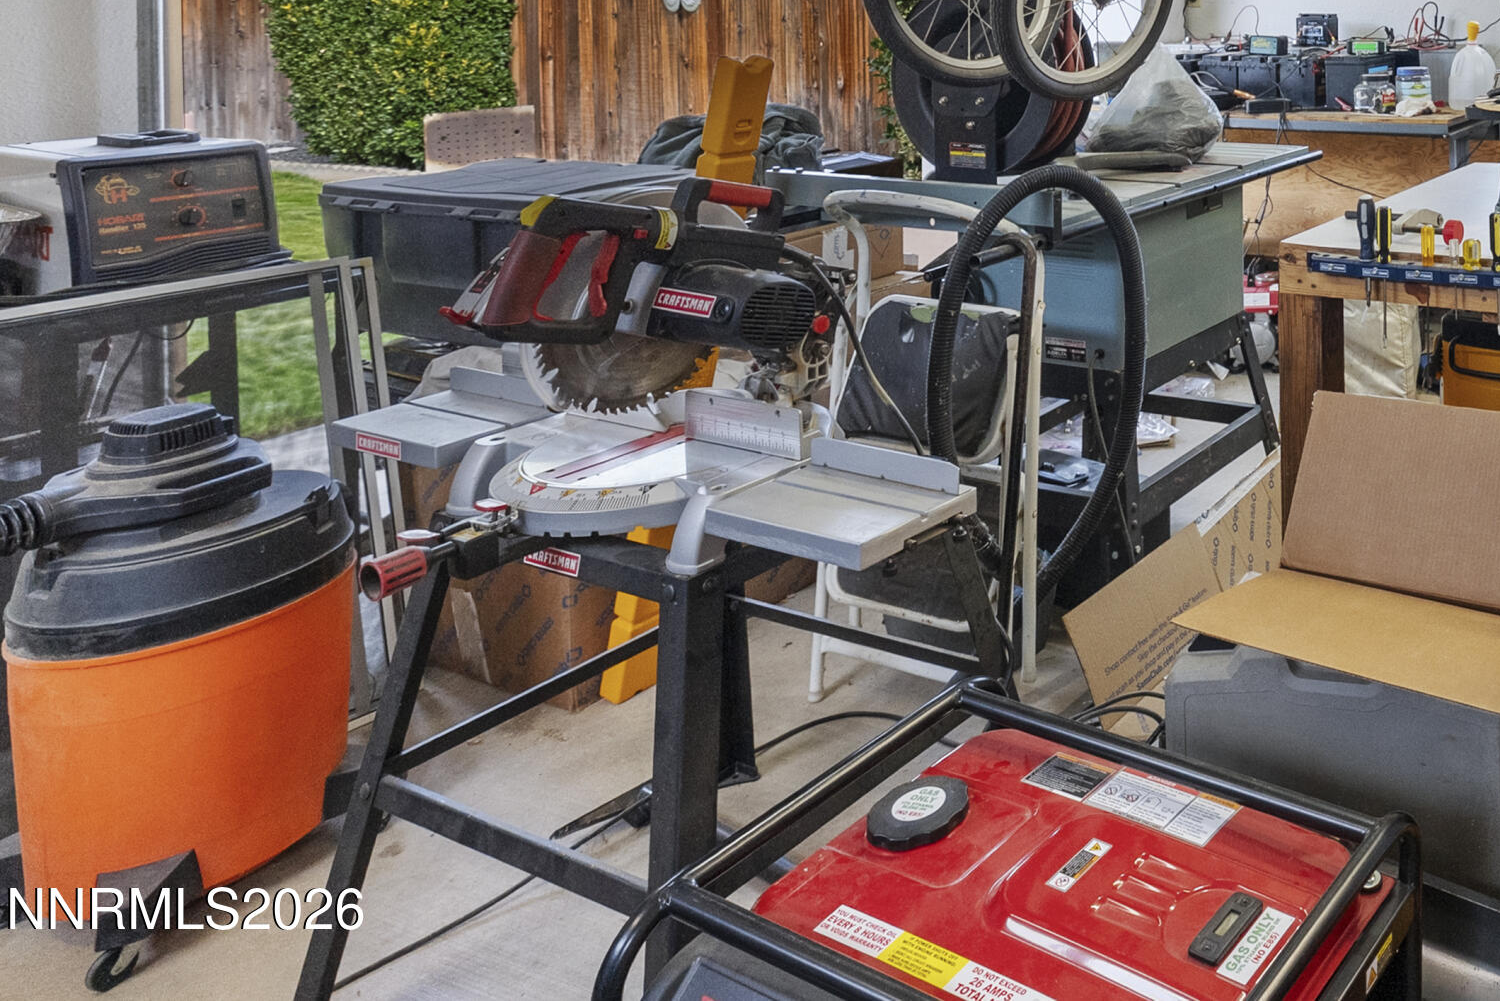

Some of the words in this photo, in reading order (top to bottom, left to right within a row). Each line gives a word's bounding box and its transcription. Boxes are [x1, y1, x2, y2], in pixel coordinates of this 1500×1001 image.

[657, 292, 713, 312] CRAFTSMAN
[358, 436, 400, 457] CRAFTSMAN
[526, 551, 578, 572] CRAFTSMAN
[827, 915, 853, 931] EVERY
[861, 929, 890, 947] HOURS
[837, 908, 851, 919] YOU
[866, 920, 886, 934] CHECK
[848, 935, 883, 953] WARRANTY
[1224, 944, 1250, 973] GAS
[1247, 912, 1276, 944] ONLY
[1250, 947, 1266, 965] (NO
[1263, 932, 1280, 950] E85)
[969, 976, 983, 988] 26
[983, 983, 1014, 1001] AMPS
[972, 966, 982, 975] DO
[983, 971, 999, 982] NOT
[998, 977, 1027, 996] EXCEED
